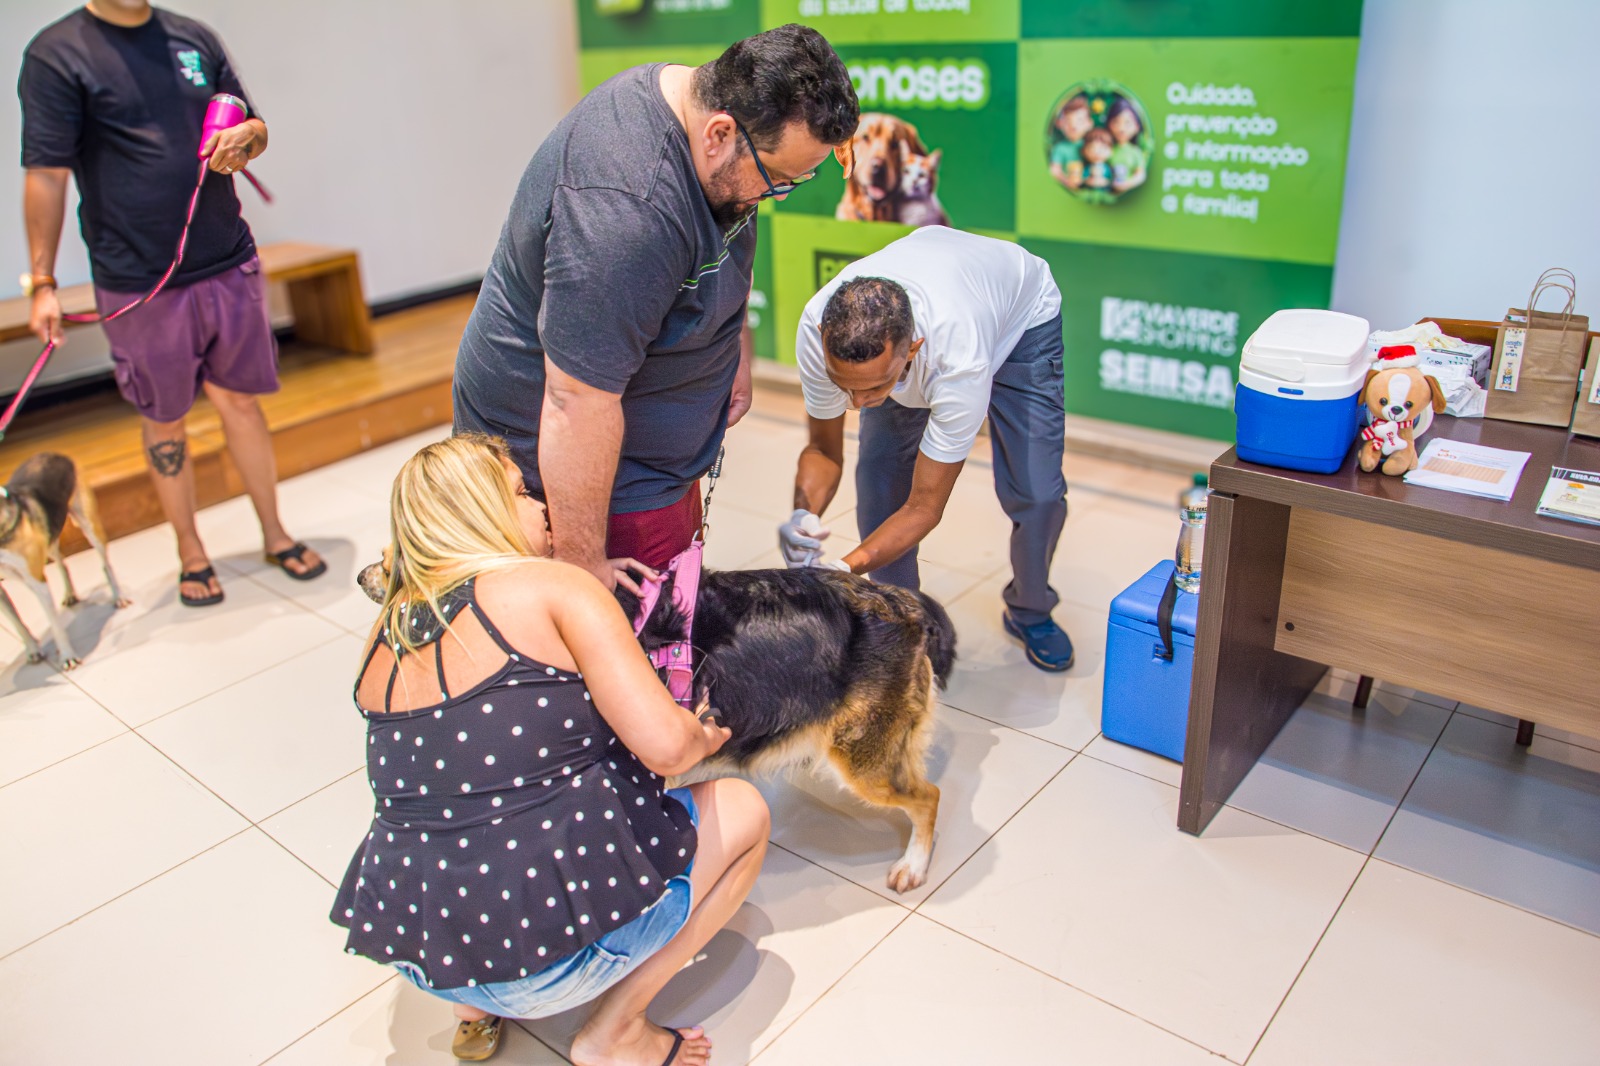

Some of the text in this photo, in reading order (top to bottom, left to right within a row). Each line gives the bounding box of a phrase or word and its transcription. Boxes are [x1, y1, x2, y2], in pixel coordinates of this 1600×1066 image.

[847, 64, 984, 103] onoses
[1165, 113, 1277, 138] prevenção
[1164, 138, 1309, 168] e informação
[1163, 168, 1270, 192] para toda
[1161, 194, 1178, 213] a
[1100, 349, 1233, 402] SEMSA
